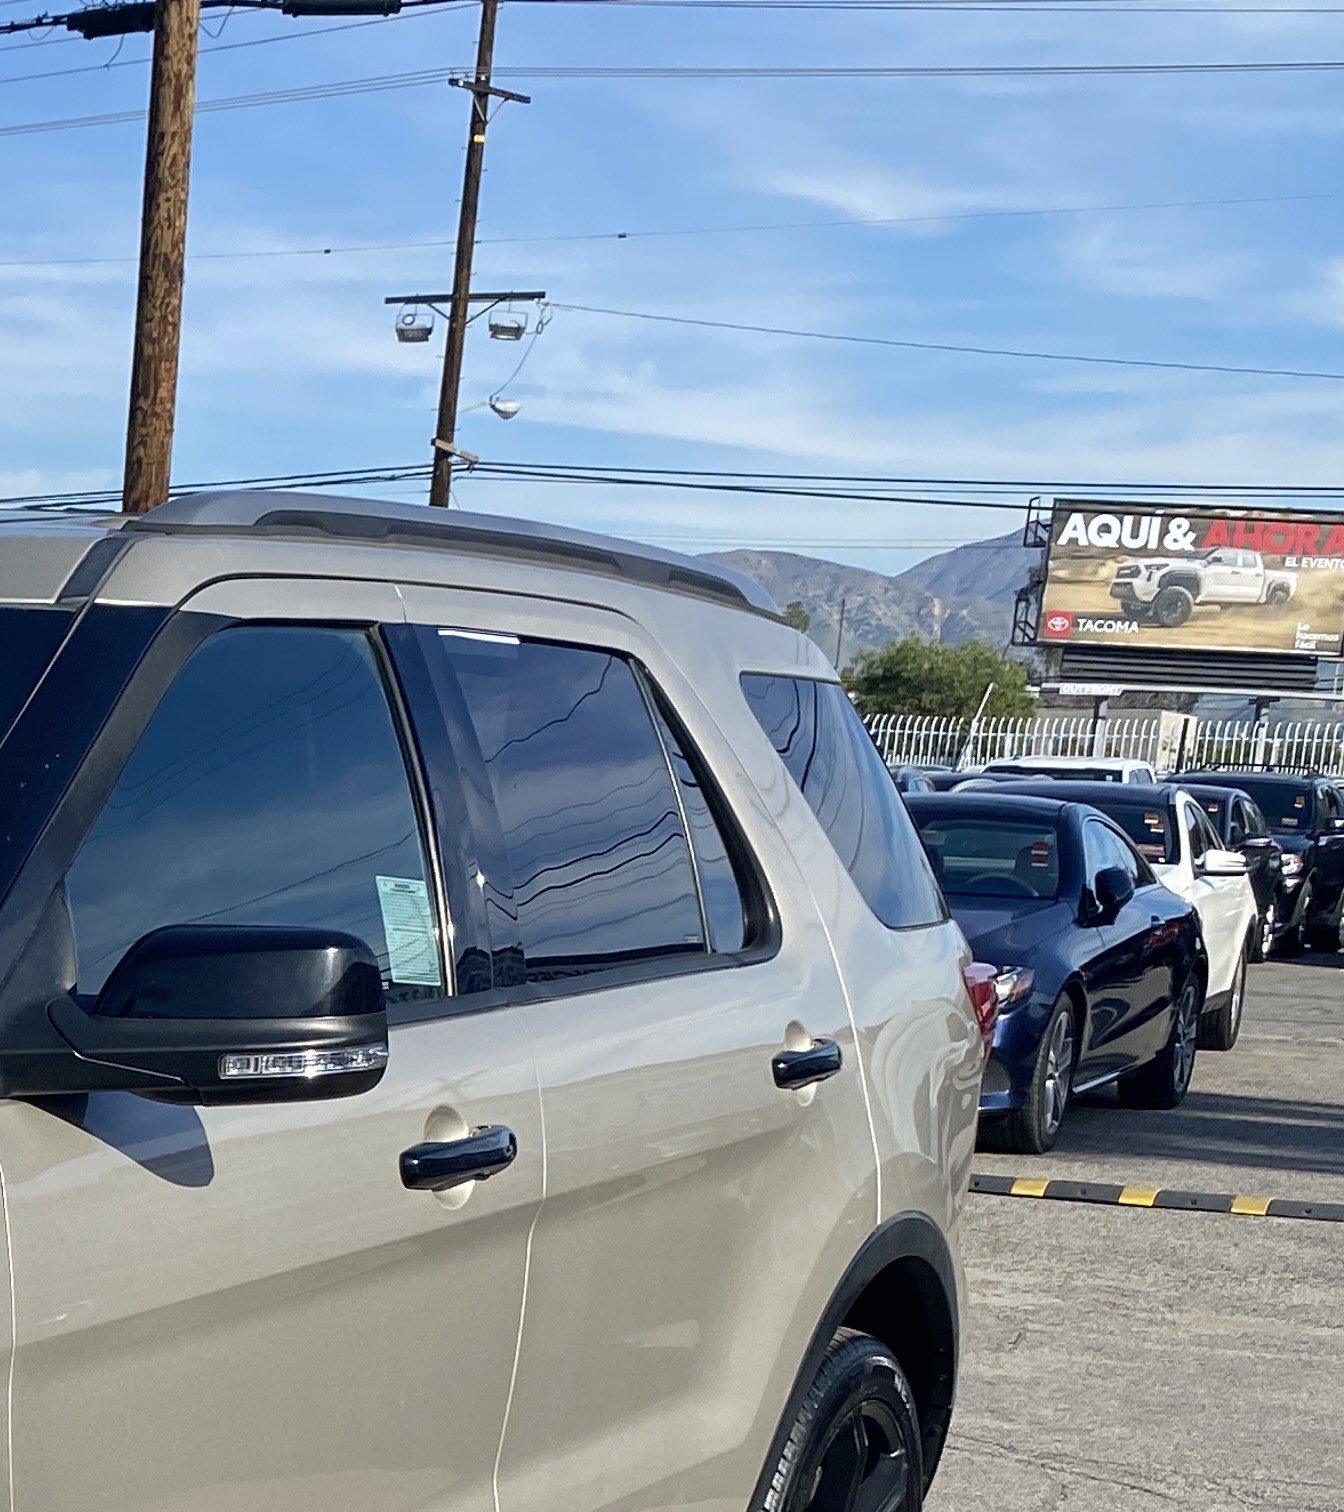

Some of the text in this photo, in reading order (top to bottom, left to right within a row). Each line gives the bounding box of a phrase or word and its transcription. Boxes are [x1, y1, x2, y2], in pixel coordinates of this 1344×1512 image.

[1057, 513, 1161, 550] AQUI
[1163, 517, 1196, 551] &
[1285, 556, 1299, 568] EL
[1077, 618, 1139, 634] TACOMA
